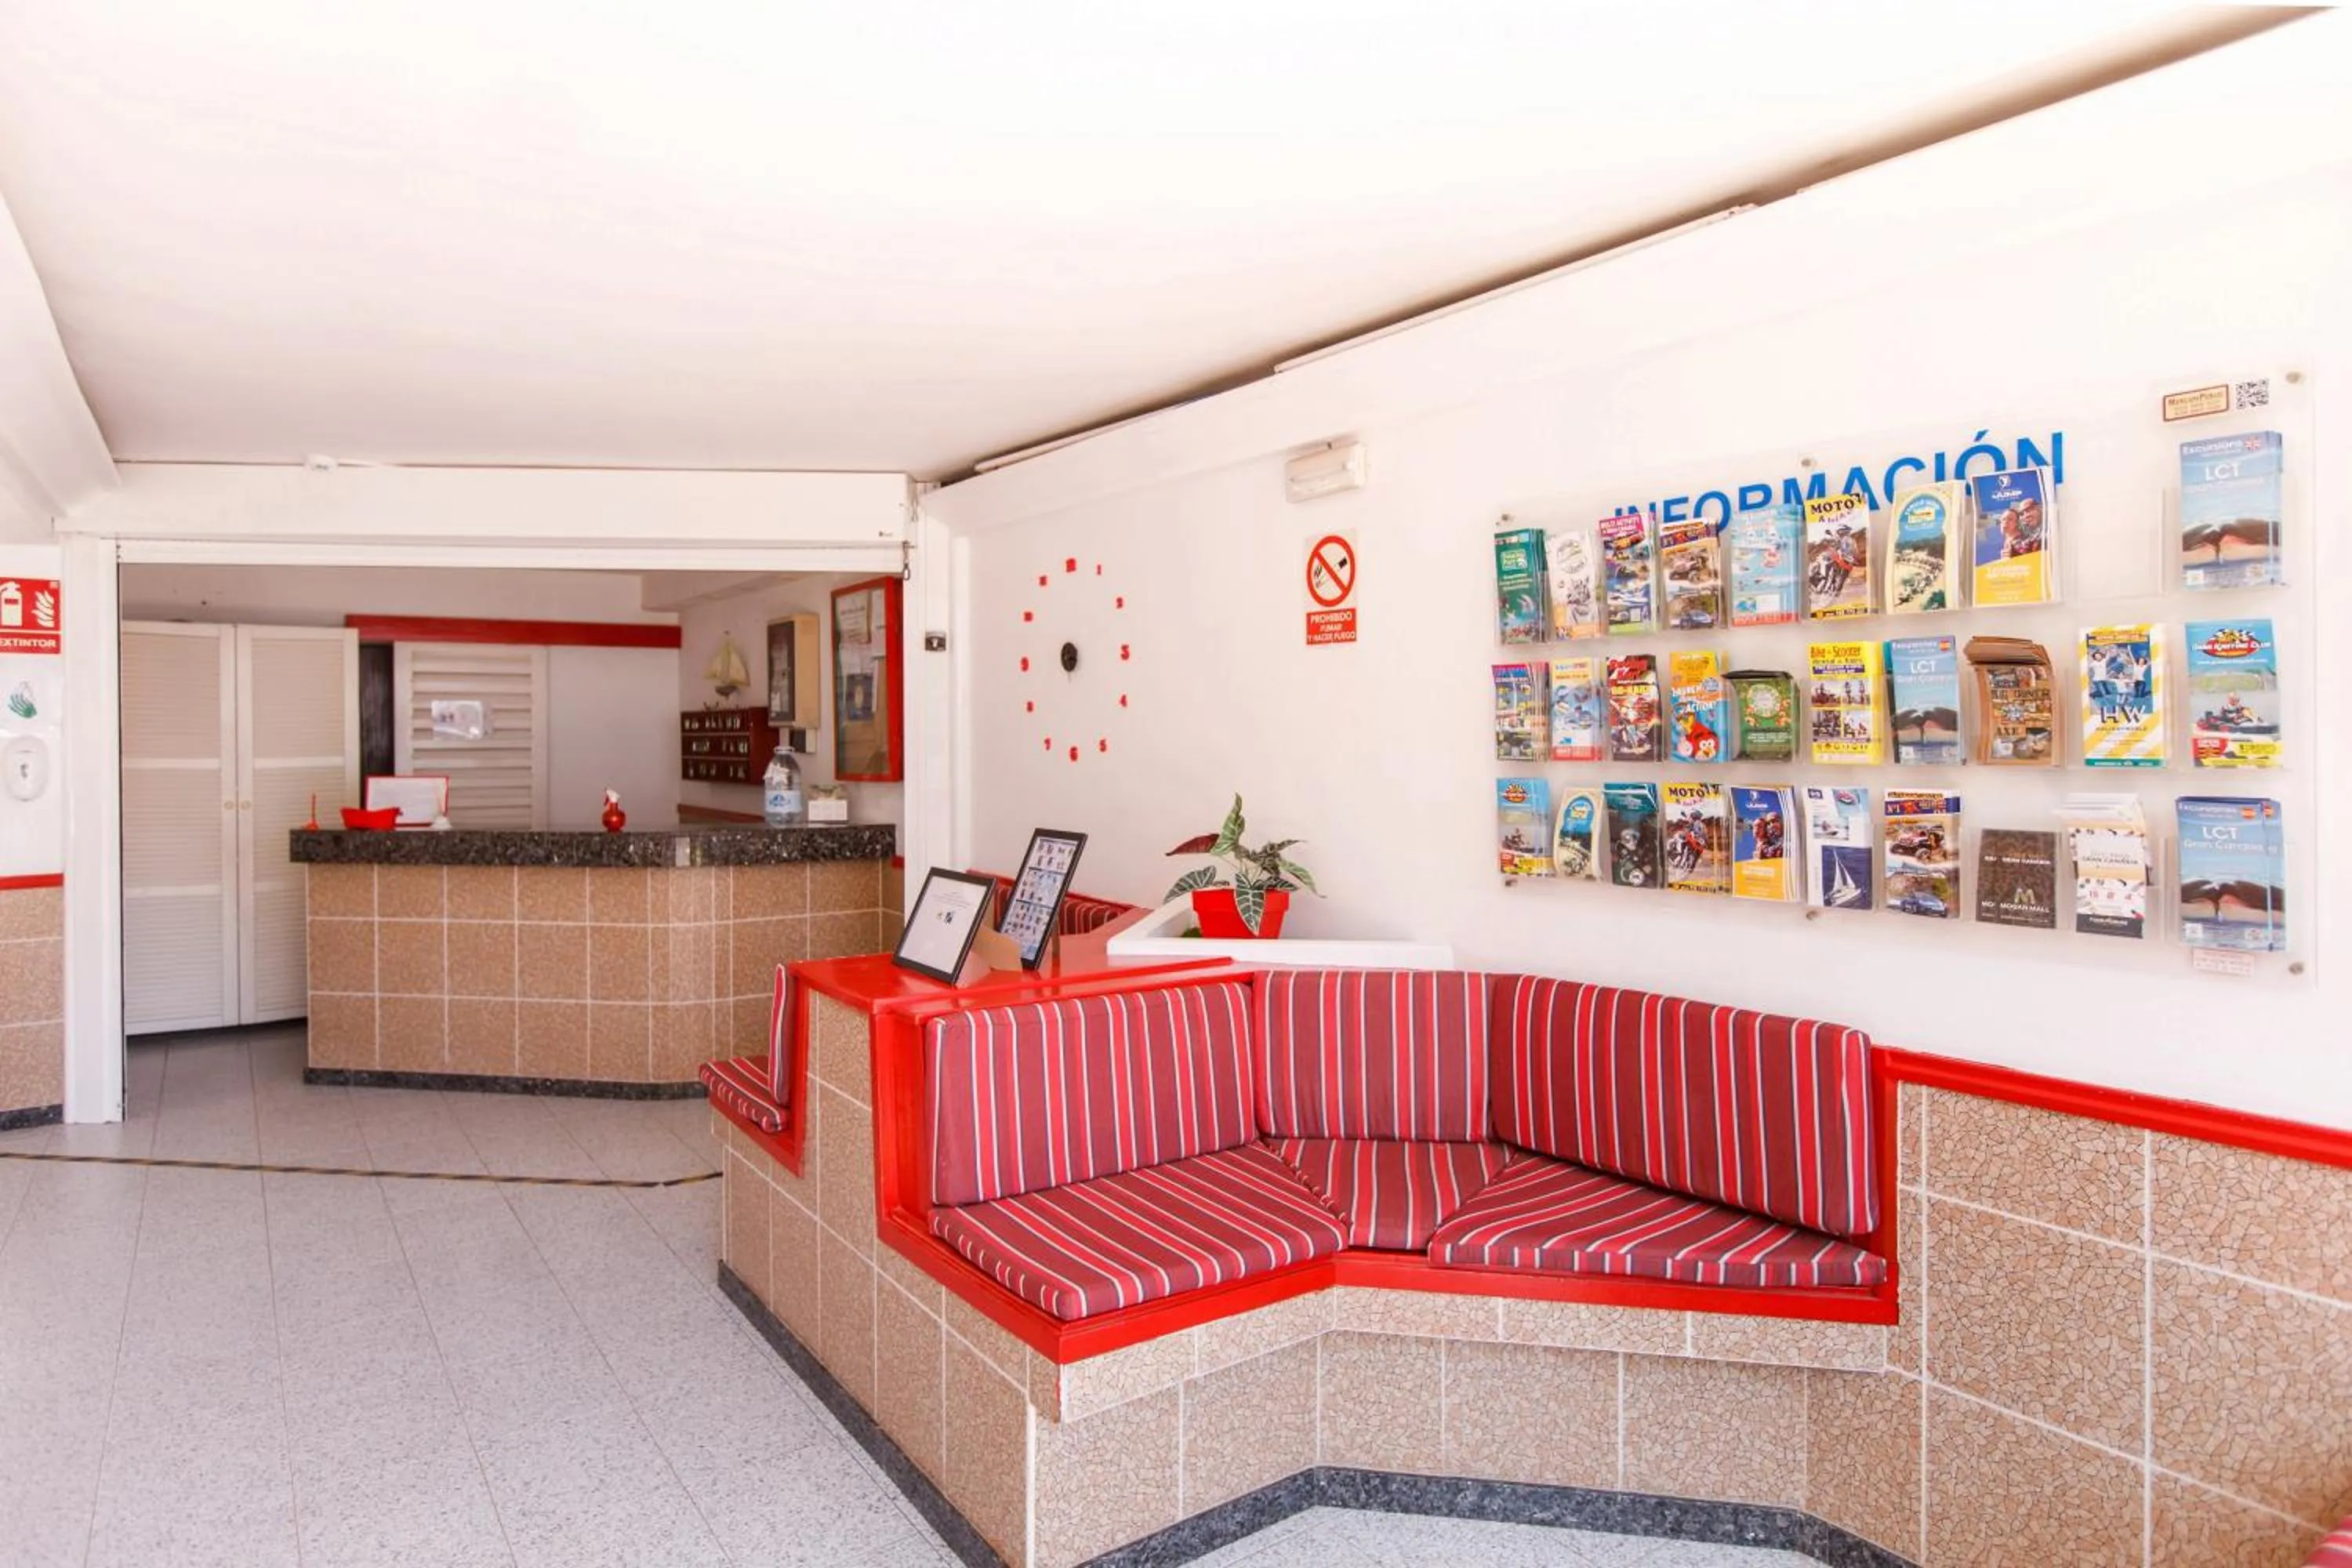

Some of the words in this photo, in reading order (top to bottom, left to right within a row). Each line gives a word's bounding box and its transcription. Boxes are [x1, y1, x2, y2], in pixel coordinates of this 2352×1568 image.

[2205, 463, 2239, 481] LCT
[1613, 430, 2065, 534] FORMACIÓN
[1810, 499, 1855, 514] MOTO
[1310, 612, 1352, 624] PROHIBIDO
[1334, 631, 1356, 641] FUEGO
[1910, 660, 1936, 674] LCT
[1668, 786, 1705, 798] MOTO
[2201, 826, 2239, 840] LCT
